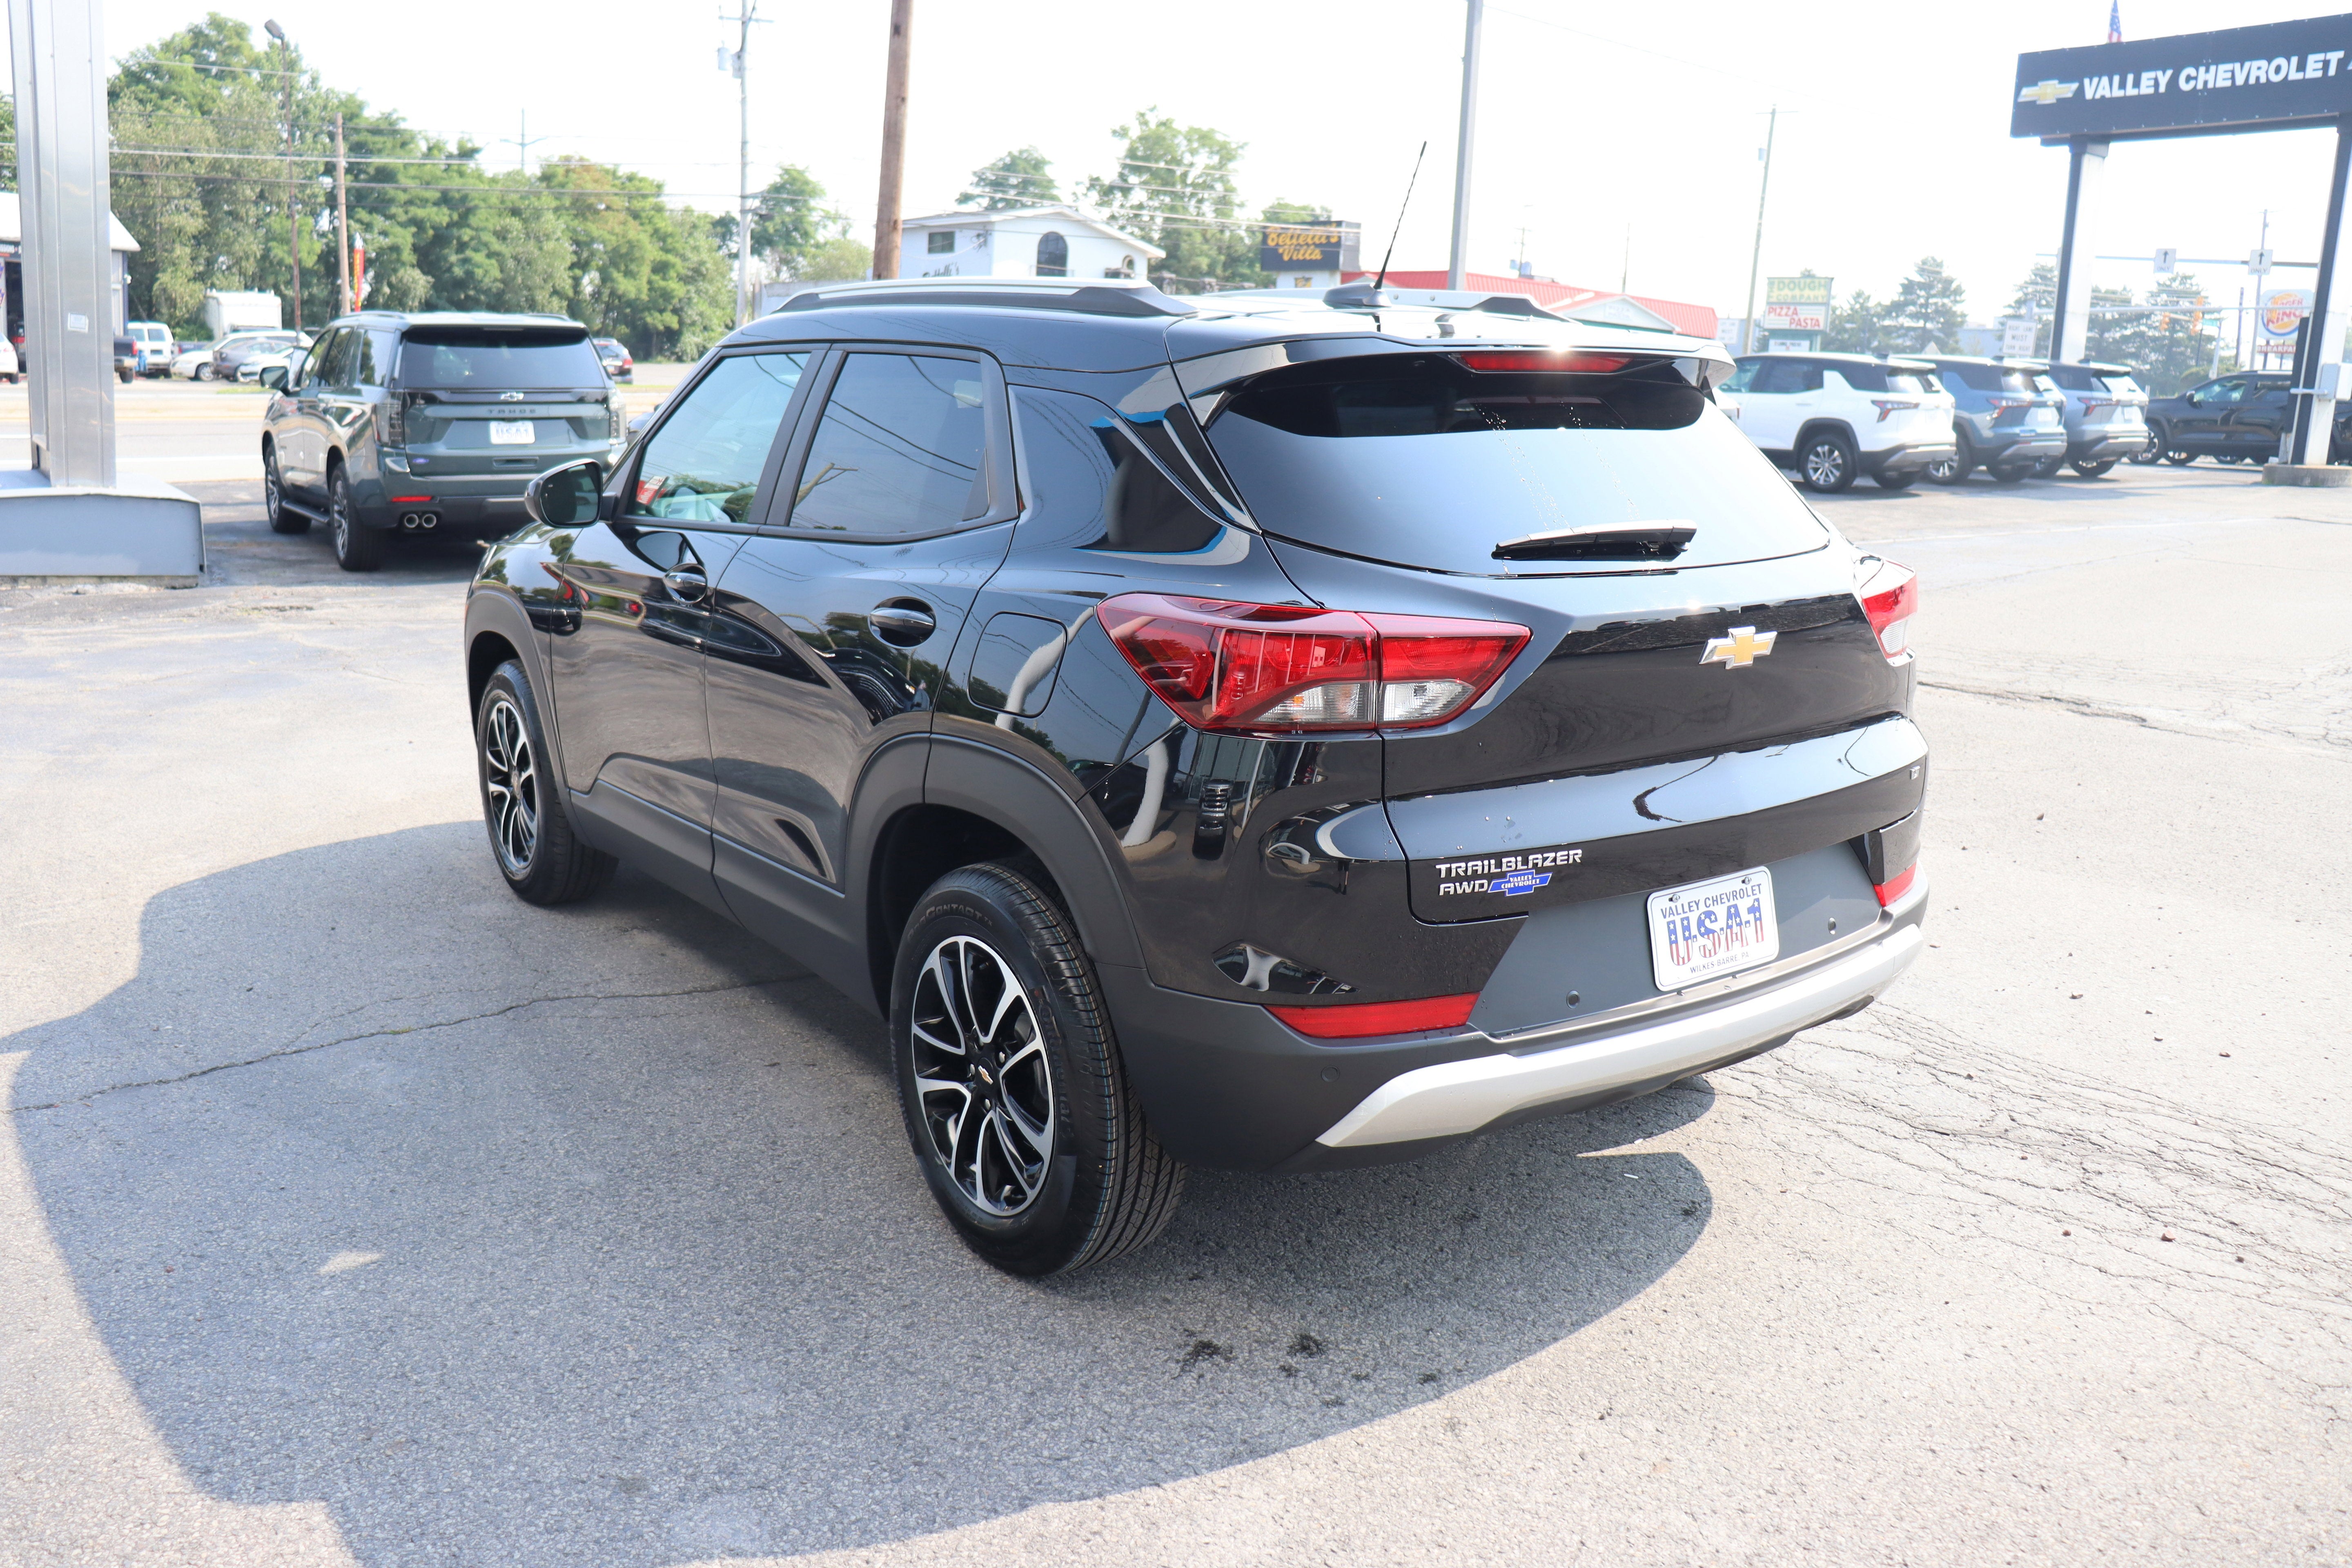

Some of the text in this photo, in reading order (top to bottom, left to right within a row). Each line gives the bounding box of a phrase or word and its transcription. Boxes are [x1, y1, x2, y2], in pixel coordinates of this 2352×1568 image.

[2083, 50, 2345, 100] VALLEY CHEVROLET
[1277, 245, 1323, 261] Villa
[1777, 281, 1827, 291] DOUGH
[1768, 306, 1798, 317] PIZZA
[1789, 318, 1821, 328] PASTA
[1435, 849, 1582, 878] TRAILBLAZER
[1501, 878, 1541, 889] CHEVROLET
[1509, 874, 1533, 883] VALLEY
[1439, 880, 1488, 896] AWD
[1660, 883, 1762, 919] VALLEY CHEVROLET
[1741, 951, 1749, 960] PA
